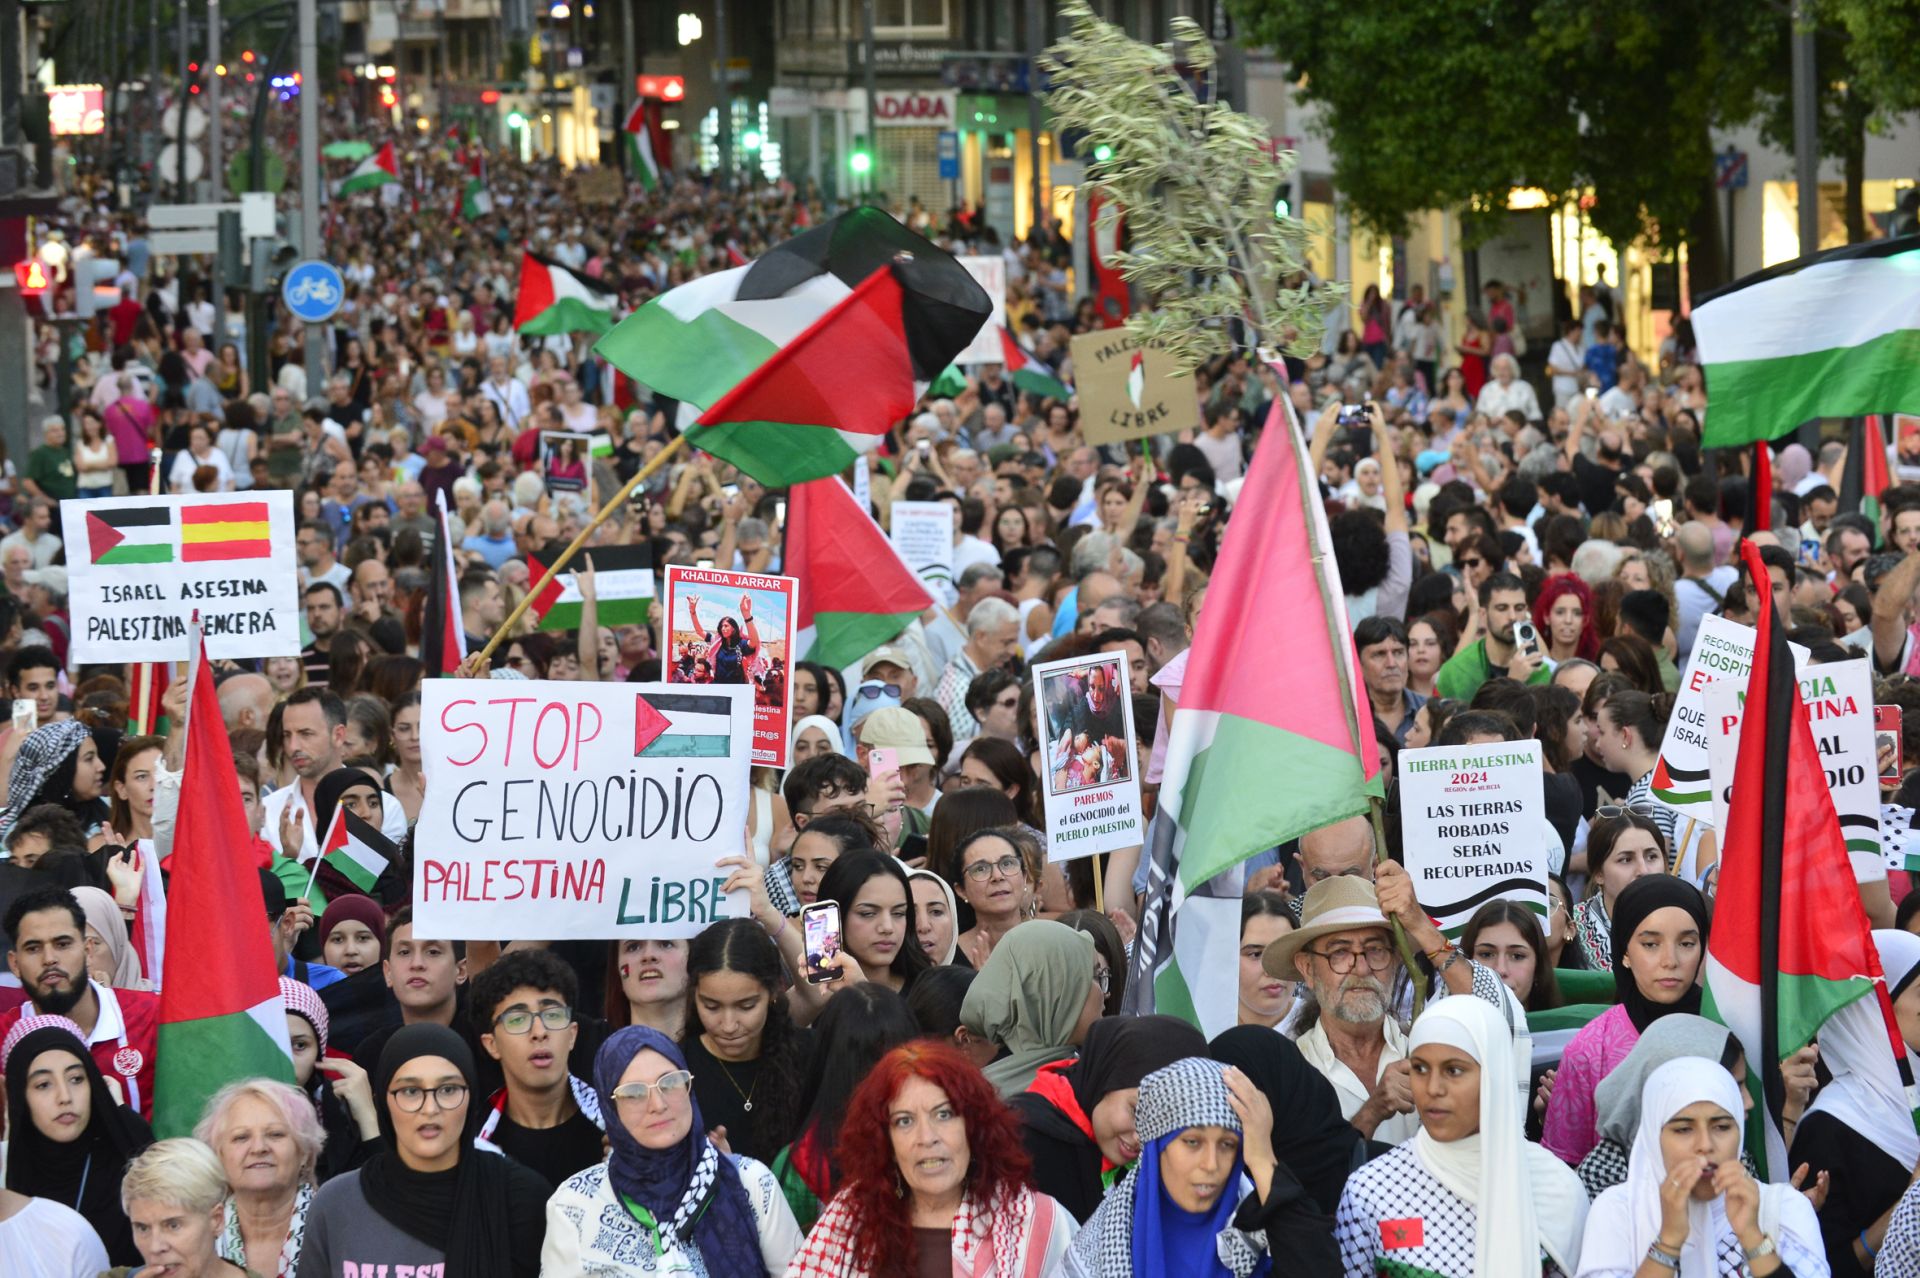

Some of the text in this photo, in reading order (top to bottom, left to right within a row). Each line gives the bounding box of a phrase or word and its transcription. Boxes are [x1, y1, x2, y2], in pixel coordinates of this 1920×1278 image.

[1110, 402, 1168, 427] LIBRE
[100, 579, 267, 603] ISRAEL ASESINA
[681, 570, 781, 590] KHALIDA JARRAR
[88, 608, 276, 641] PALESTINA ENCERÁ
[1698, 648, 1752, 677] HOSPIT
[1678, 706, 1706, 728] QUE
[441, 698, 602, 771] STOP
[1408, 752, 1534, 773] TIERRA PALESTINA
[1451, 771, 1488, 785] 2024
[452, 767, 723, 843] GENOCIDIO
[1074, 790, 1114, 807] PAREMOS
[1427, 800, 1523, 818] LAS TIERRAS
[1060, 803, 1130, 826] el GENOCIDIO del
[1056, 818, 1136, 843] PUEBLO PALESTINO
[1438, 822, 1509, 838] ROBADAS
[1453, 841, 1501, 858] SERÁN
[1424, 860, 1533, 880] RECUPERADAS
[423, 858, 730, 925] PALESTINA LIBRE
